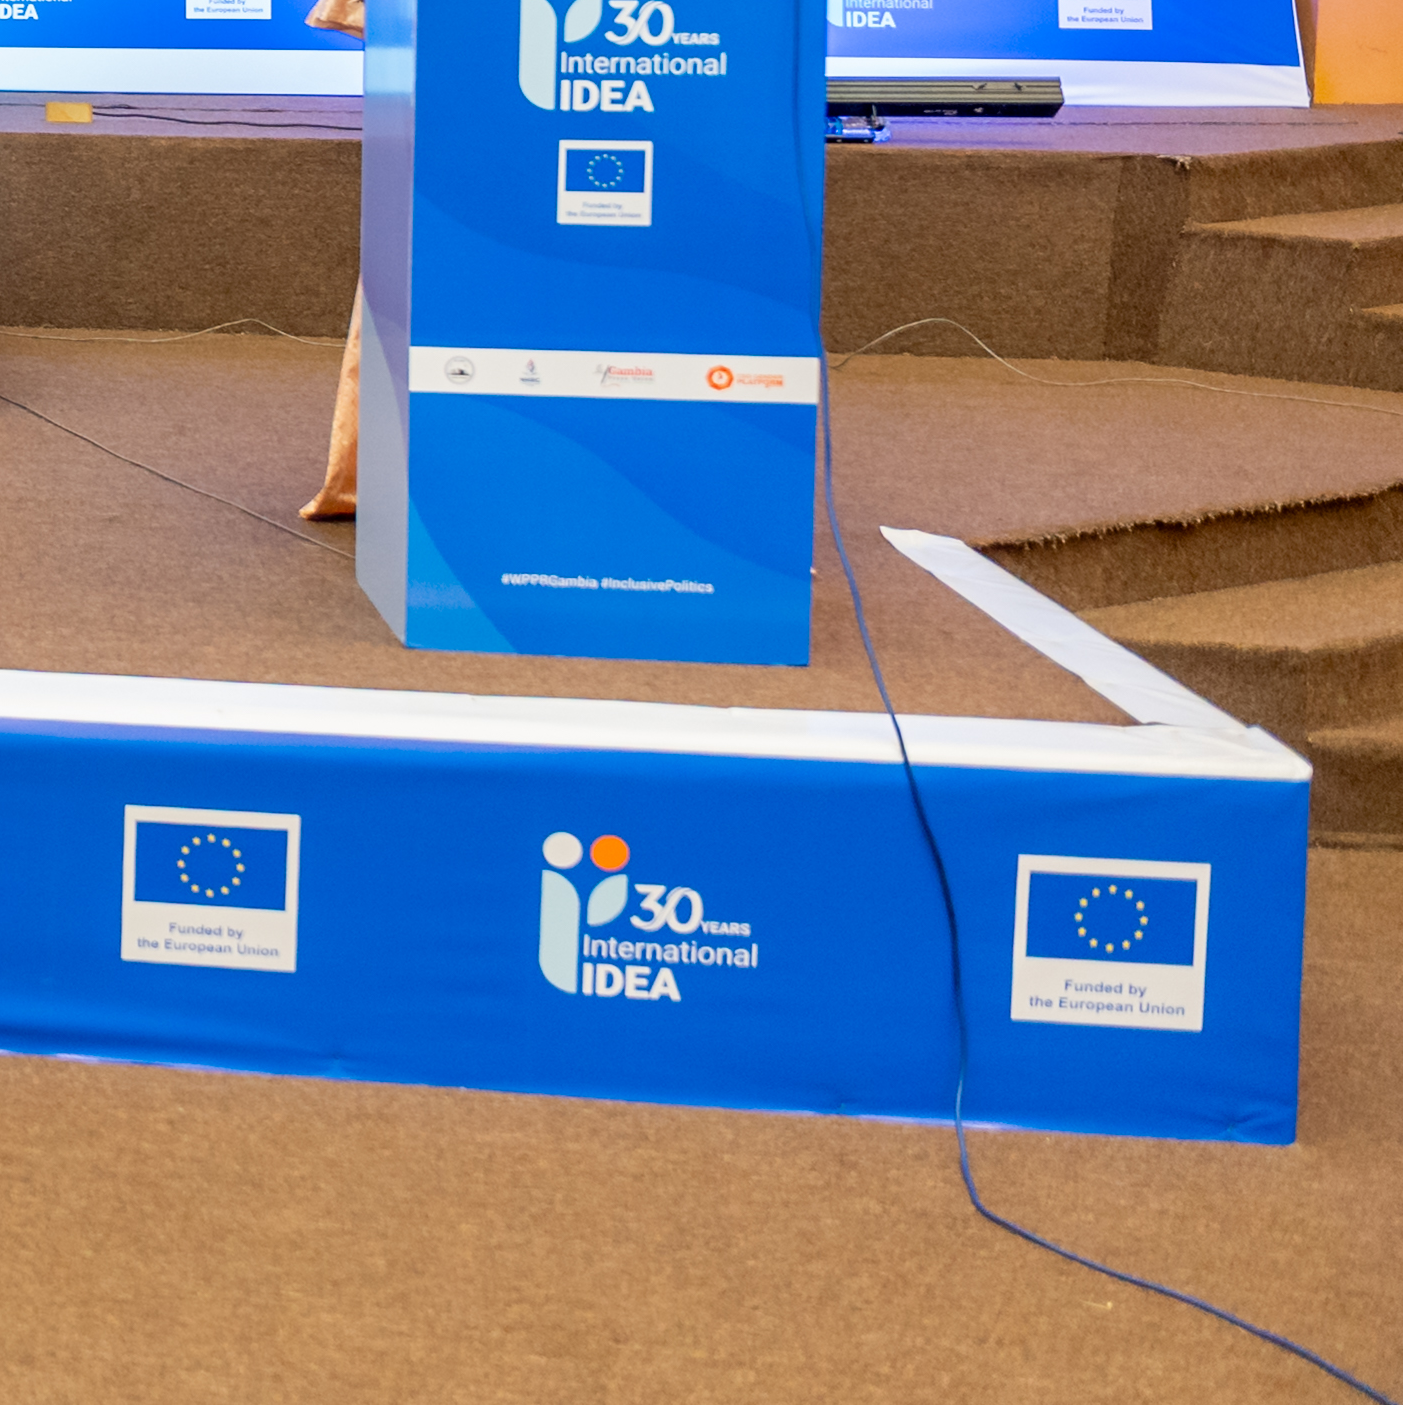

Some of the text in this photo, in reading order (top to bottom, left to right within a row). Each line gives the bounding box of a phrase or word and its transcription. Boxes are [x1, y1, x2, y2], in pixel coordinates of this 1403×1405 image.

[604, 0, 720, 46] 30 YEARS
[561, 51, 727, 76] International
[560, 79, 654, 112] IDEA
[501, 573, 714, 594] #WPPRGambia #InclusivePolitics
[629, 883, 751, 938] 30 YEARS
[583, 934, 758, 968] International
[582, 962, 681, 1002] IDEA
[1064, 979, 1146, 998] Funded by
[1029, 996, 1185, 1016] the European Union
